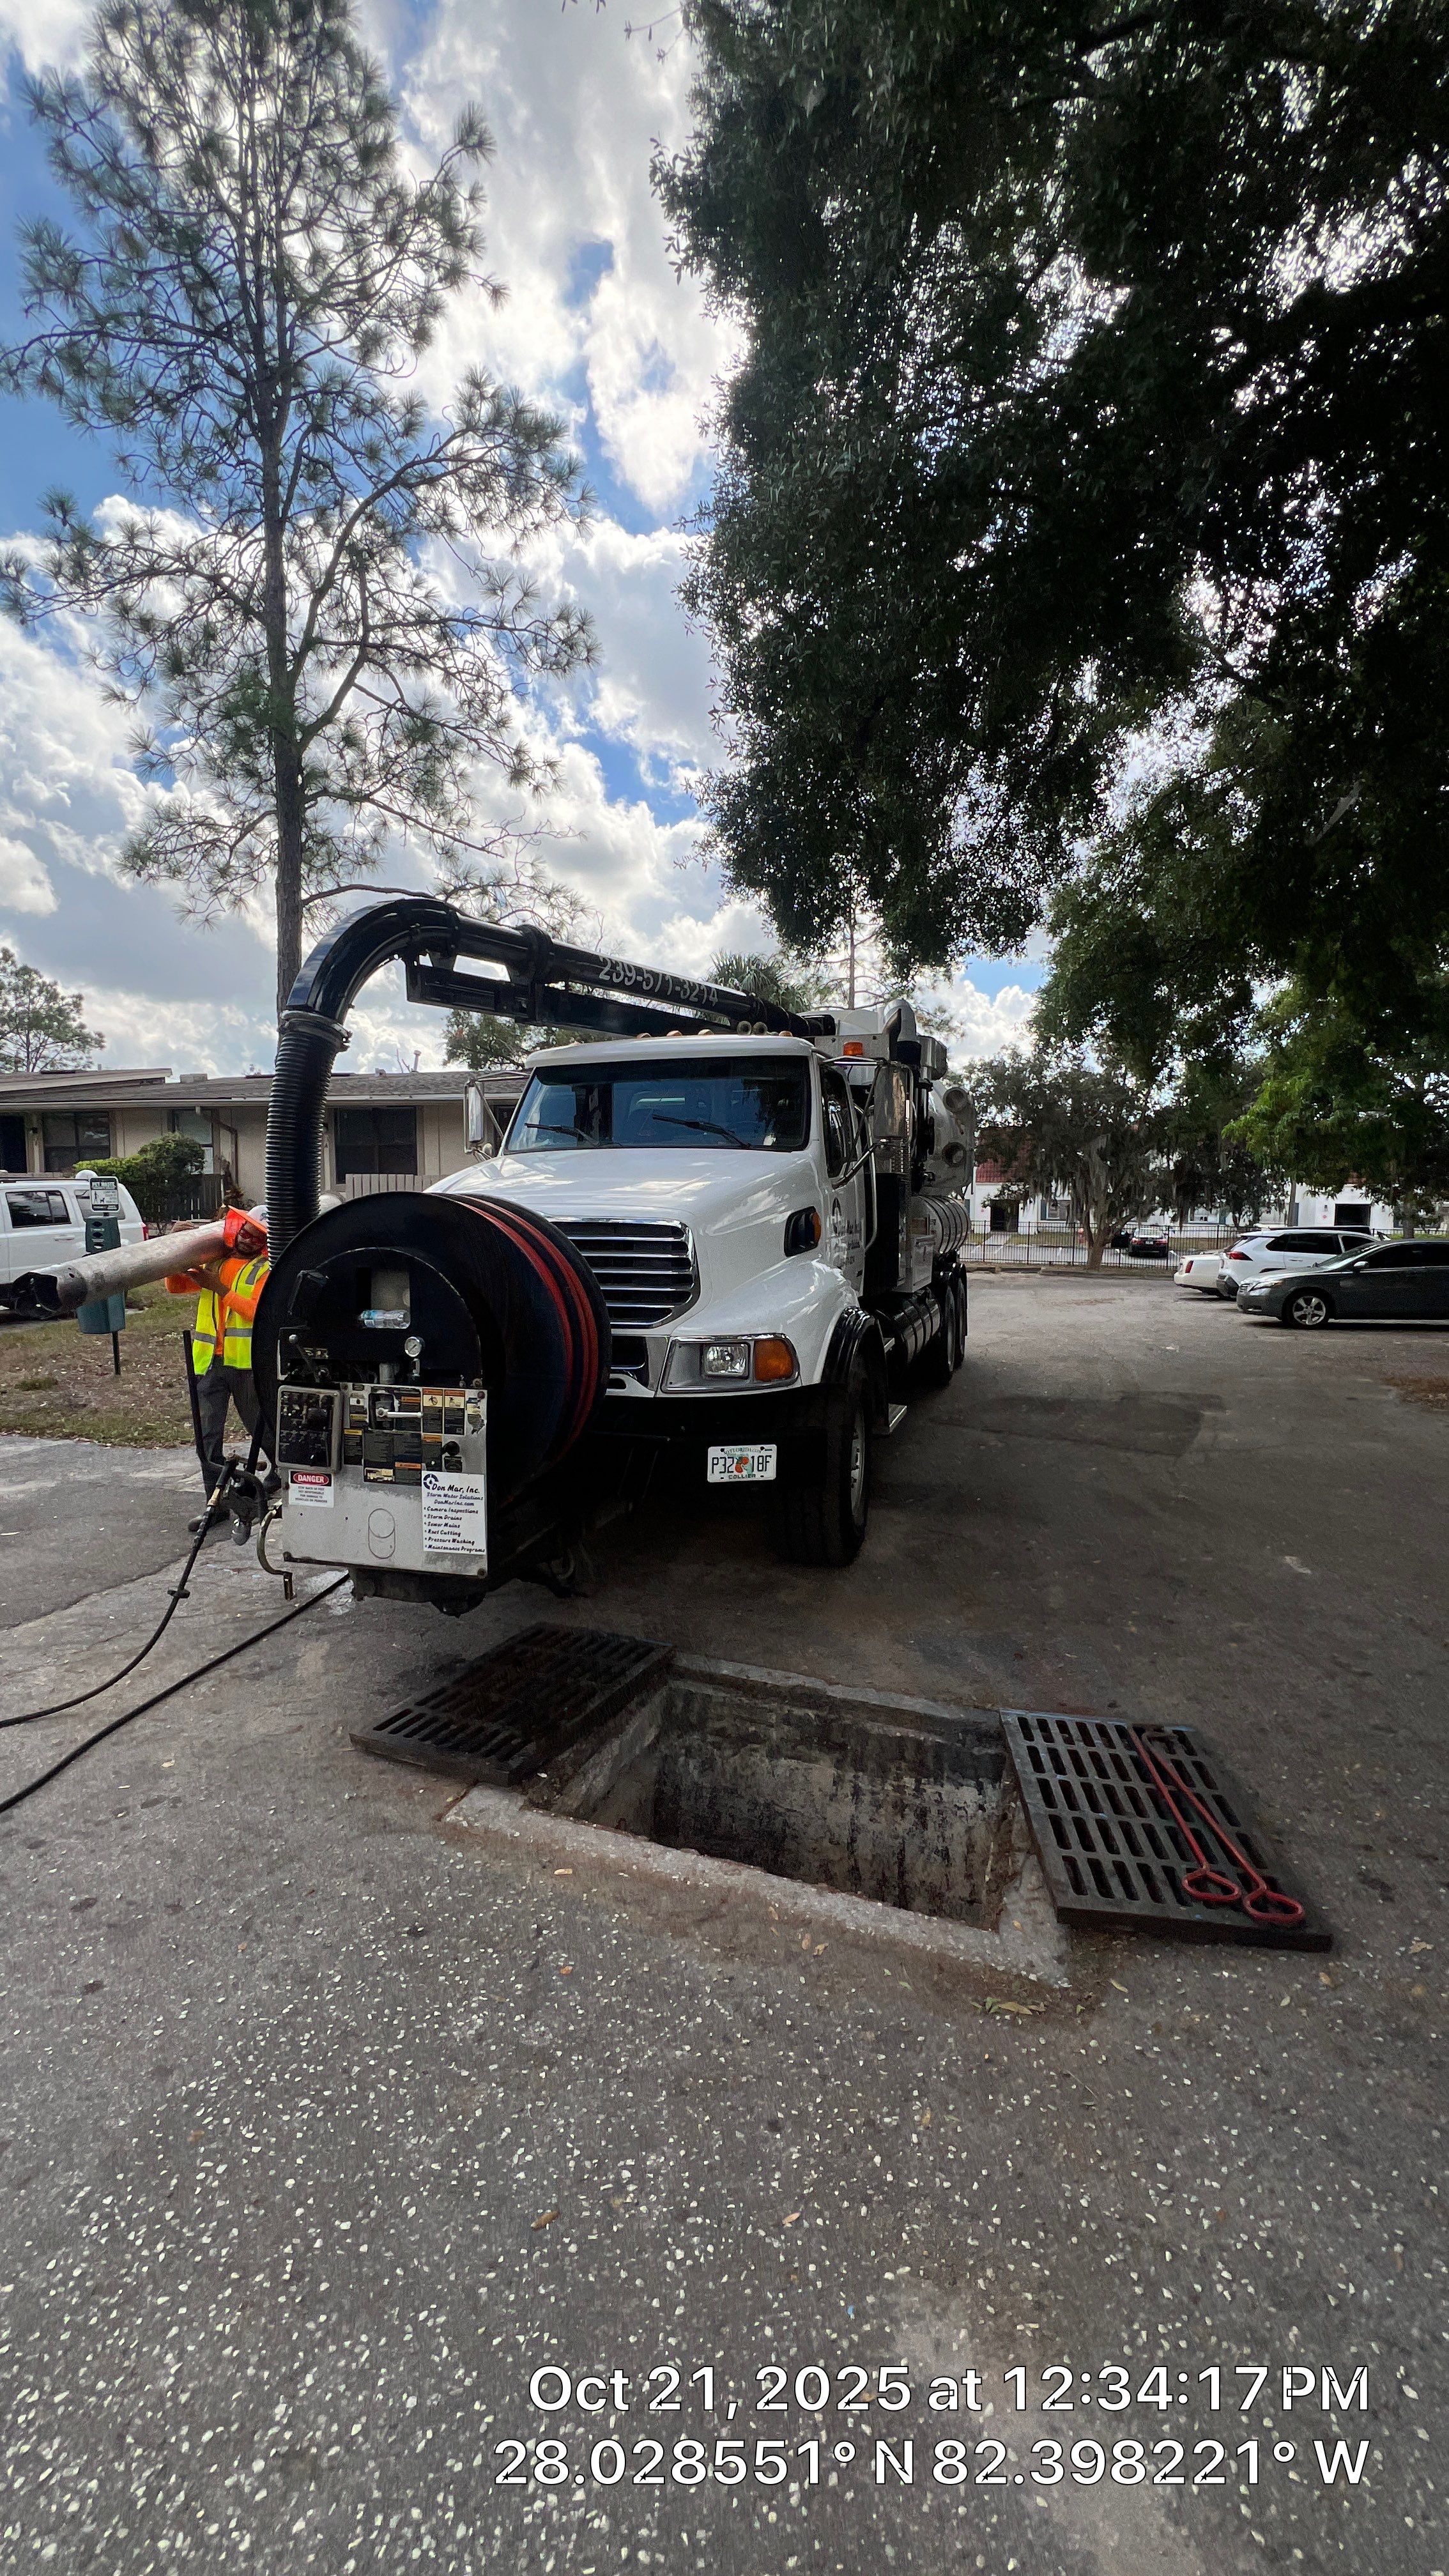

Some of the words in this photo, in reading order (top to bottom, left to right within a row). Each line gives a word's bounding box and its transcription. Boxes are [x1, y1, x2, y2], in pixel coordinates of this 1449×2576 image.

[712, 1457, 735, 1474] P32
[751, 1455, 772, 1472] 18F
[298, 1474, 325, 1483] DANGER
[432, 1483, 446, 1491] Don
[447, 1484, 464, 1494] Mar,
[466, 1485, 480, 1494] Inc.
